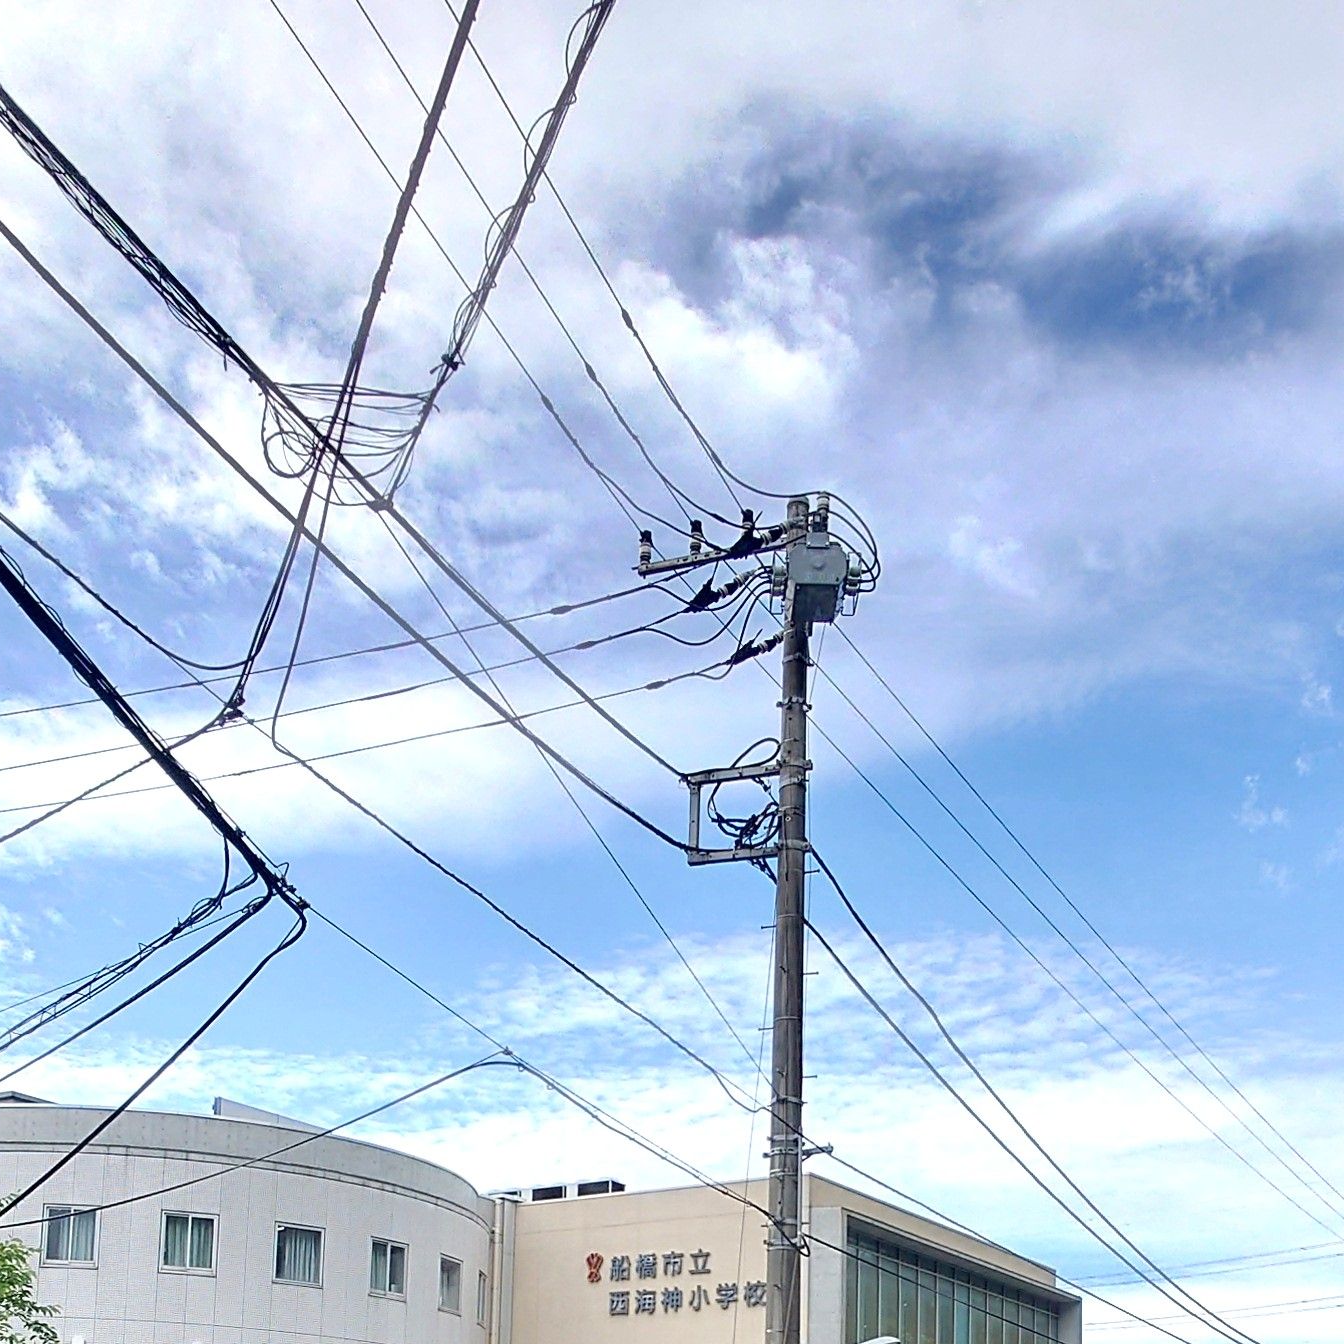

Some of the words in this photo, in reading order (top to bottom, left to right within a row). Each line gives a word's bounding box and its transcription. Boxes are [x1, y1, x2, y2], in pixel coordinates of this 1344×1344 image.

[610, 1248, 711, 1282] 船橋市立
[609, 1280, 767, 1316] 西海神小学校
